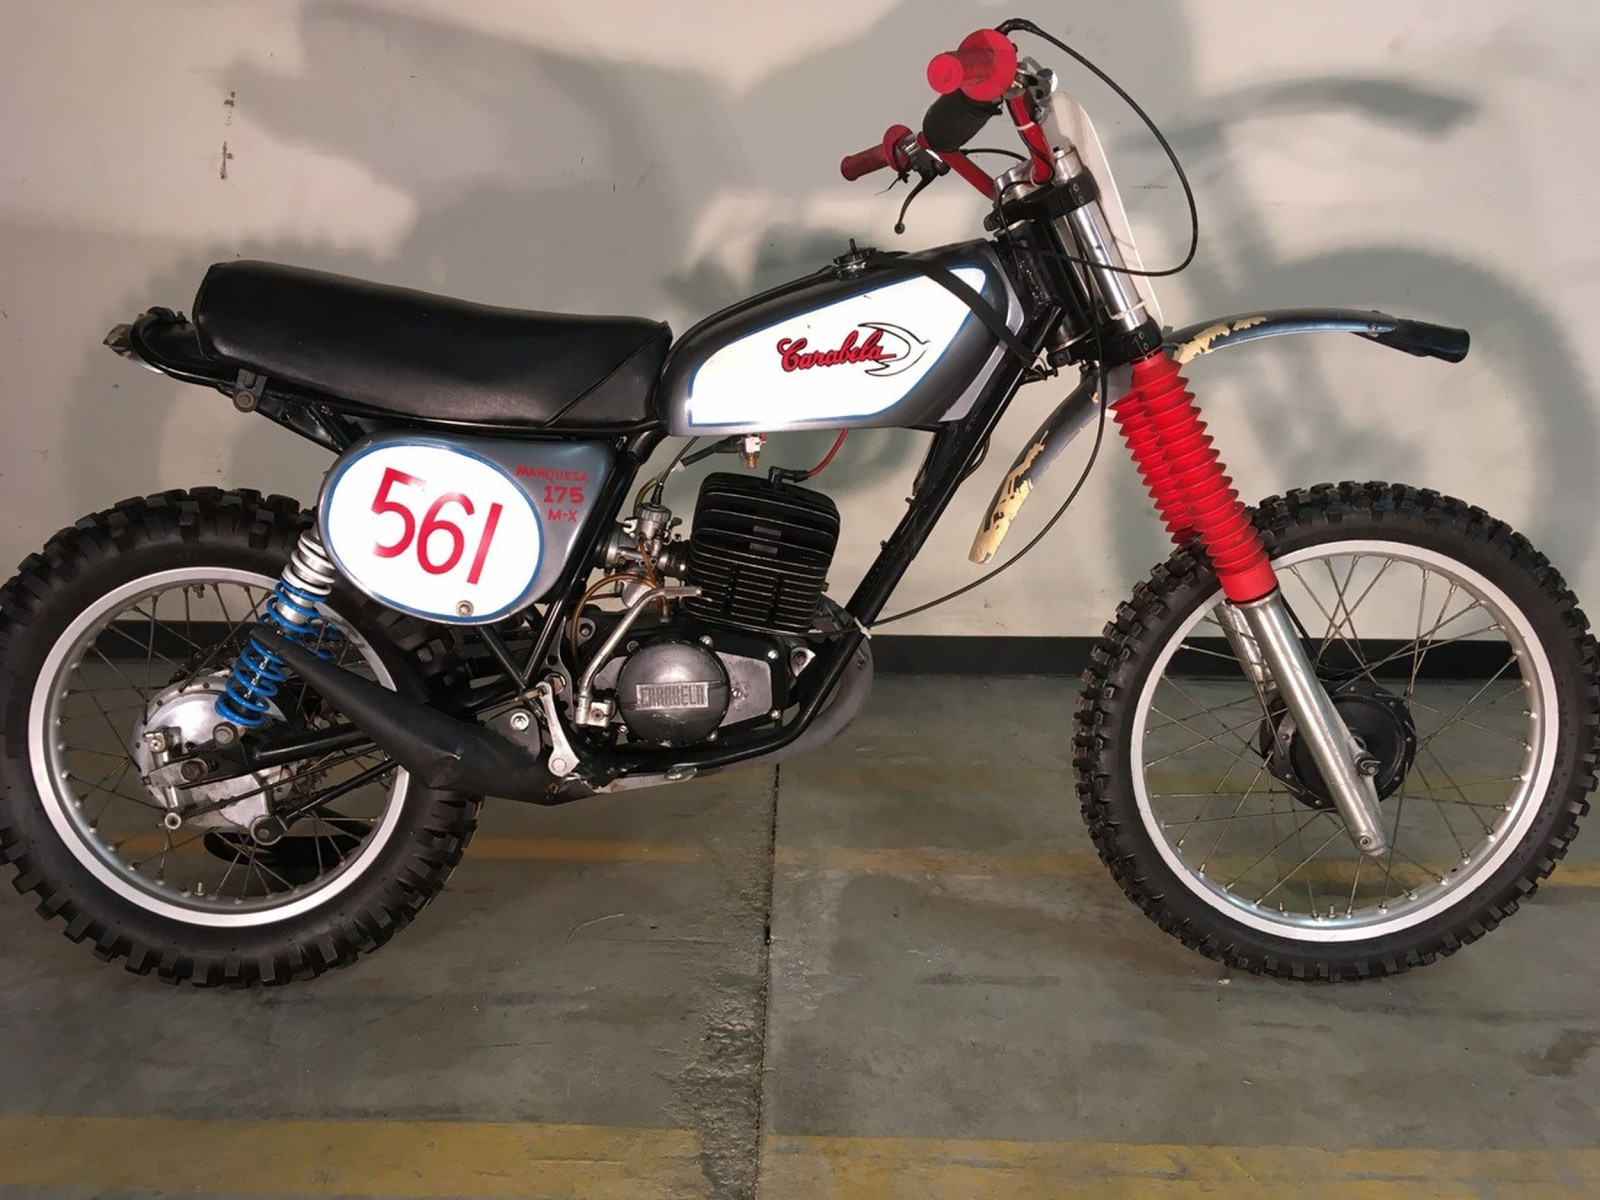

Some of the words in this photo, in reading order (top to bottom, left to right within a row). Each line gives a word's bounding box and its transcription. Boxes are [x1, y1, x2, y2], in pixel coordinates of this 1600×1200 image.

[777, 330, 897, 372] Carabela
[515, 465, 589, 483] MARQUESA
[544, 485, 584, 504] 175
[548, 508, 578, 521] M-X
[371, 467, 503, 585] 561
